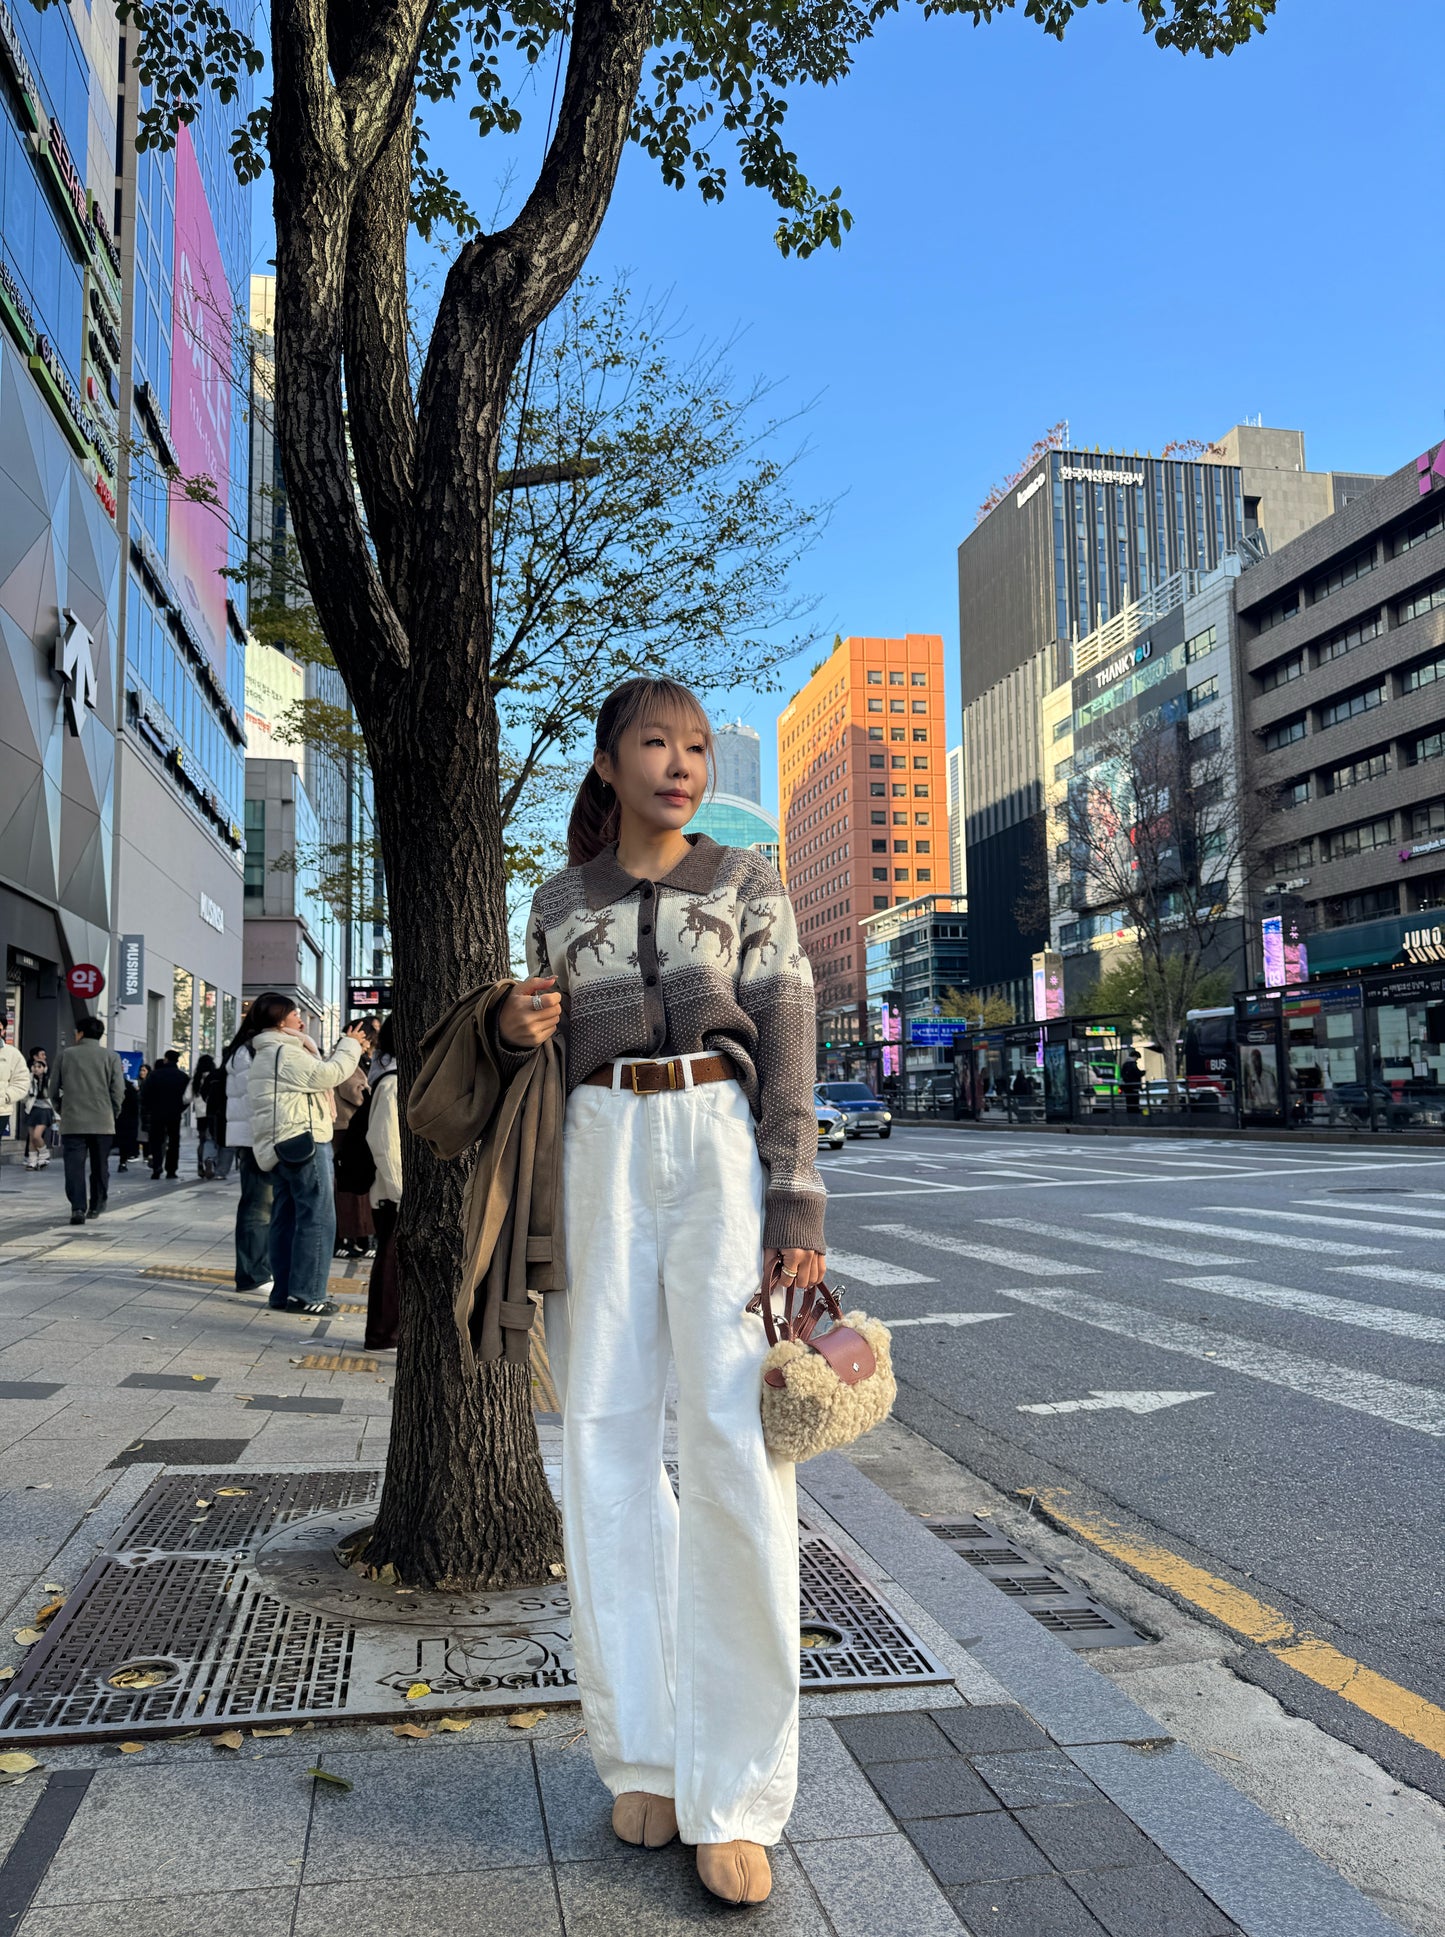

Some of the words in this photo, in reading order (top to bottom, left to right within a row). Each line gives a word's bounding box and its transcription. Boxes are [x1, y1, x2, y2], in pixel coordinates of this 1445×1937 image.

[179, 250, 228, 462] SALE
[1060, 465, 1145, 487] 한국자산관리공사
[1402, 926, 1442, 950] JUNO
[126, 942, 139, 996] MUSINSA
[447, 1602, 491, 1616] to
